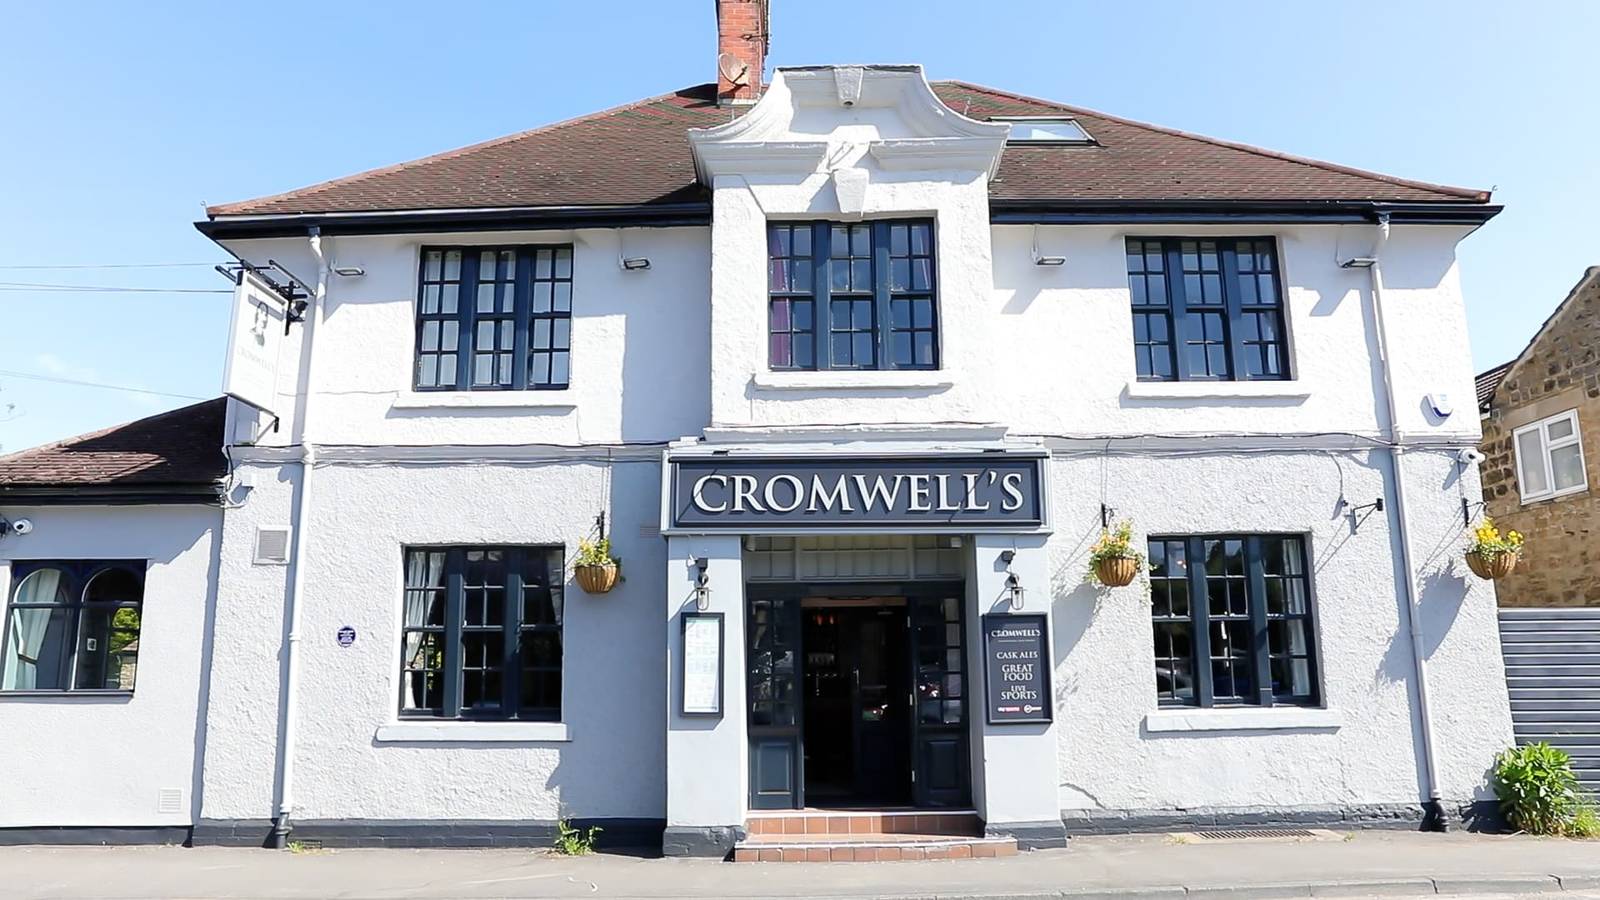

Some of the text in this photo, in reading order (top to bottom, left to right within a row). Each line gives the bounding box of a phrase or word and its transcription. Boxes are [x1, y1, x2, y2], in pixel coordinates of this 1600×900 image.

[692, 471, 1024, 513] CROMWELL'S
[996, 650, 1039, 659] CASK ALES
[1001, 664, 1034, 673] GREAT
[1003, 672, 1034, 681] FOOD
[1000, 690, 1037, 700] SPORTS
